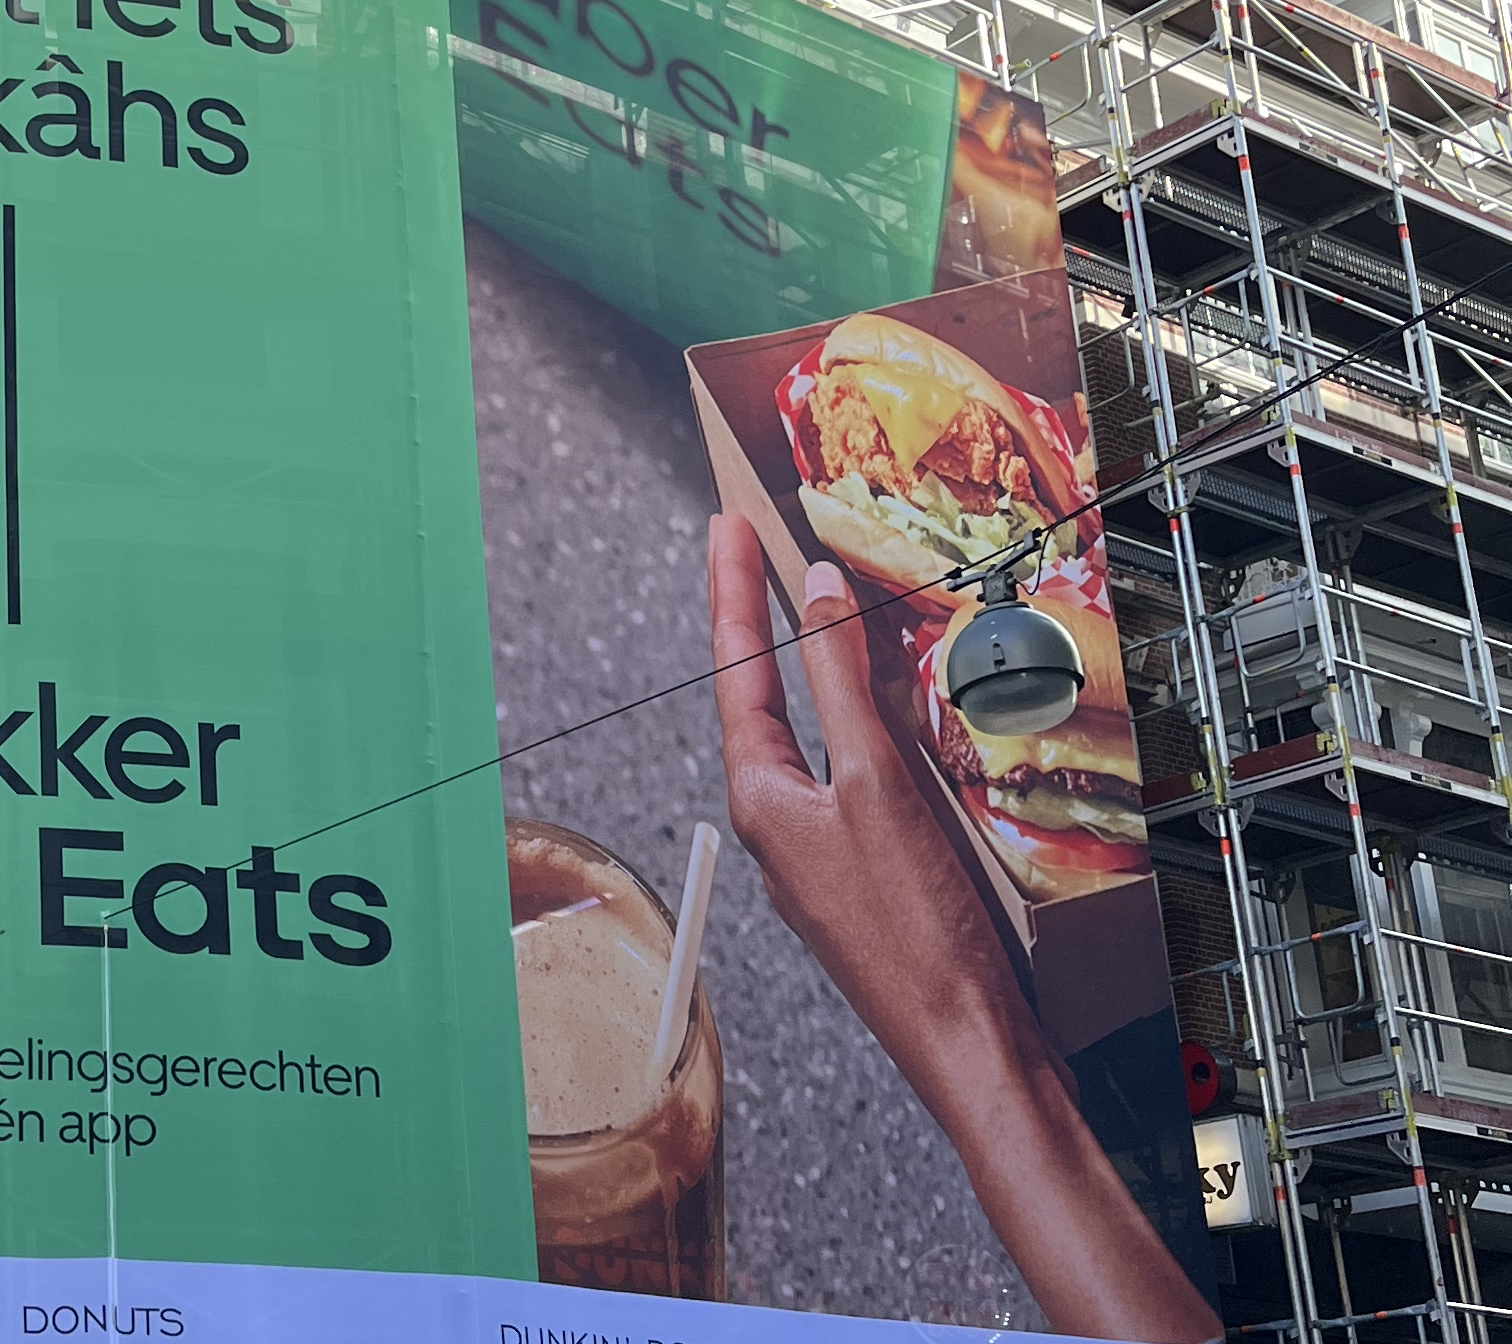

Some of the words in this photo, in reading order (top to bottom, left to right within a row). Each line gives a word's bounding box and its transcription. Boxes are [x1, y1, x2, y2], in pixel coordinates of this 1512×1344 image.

[38, 826, 393, 967] Eats
[58, 1111, 158, 1157] app
[22, 1303, 185, 1338] DONUTS
